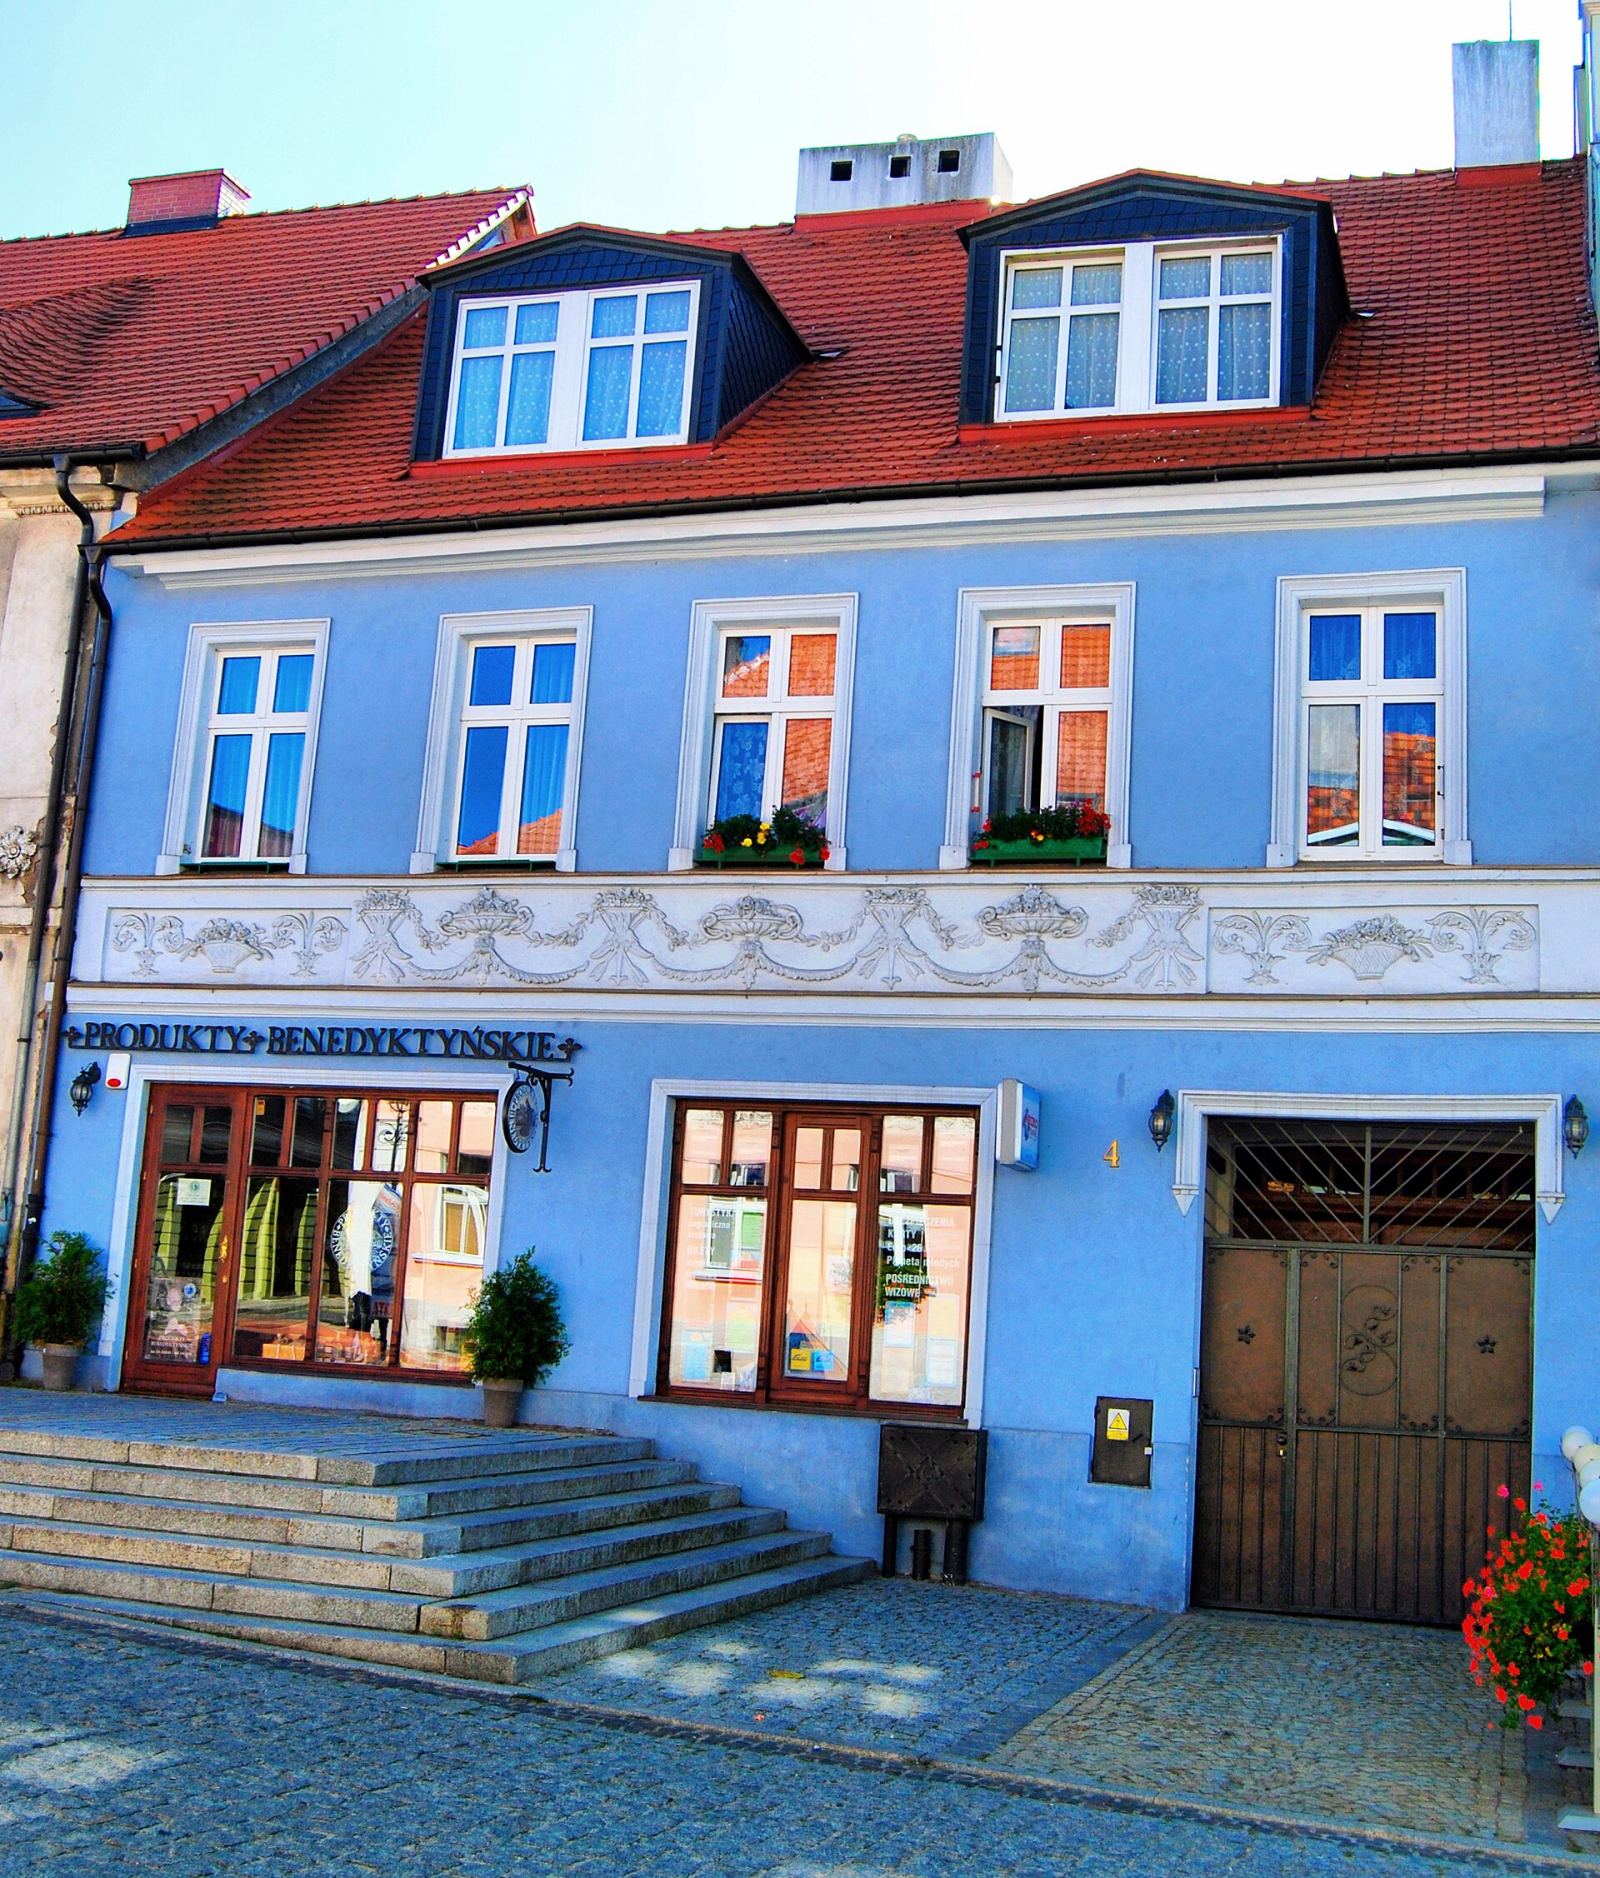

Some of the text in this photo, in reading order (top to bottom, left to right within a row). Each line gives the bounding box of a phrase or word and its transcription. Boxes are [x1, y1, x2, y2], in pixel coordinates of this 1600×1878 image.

[84, 1022, 556, 1060] PRODUKTY BENEDYKTYŃSKIE
[1103, 1138, 1120, 1168] 4
[884, 1286, 921, 1299] WIZOWE
